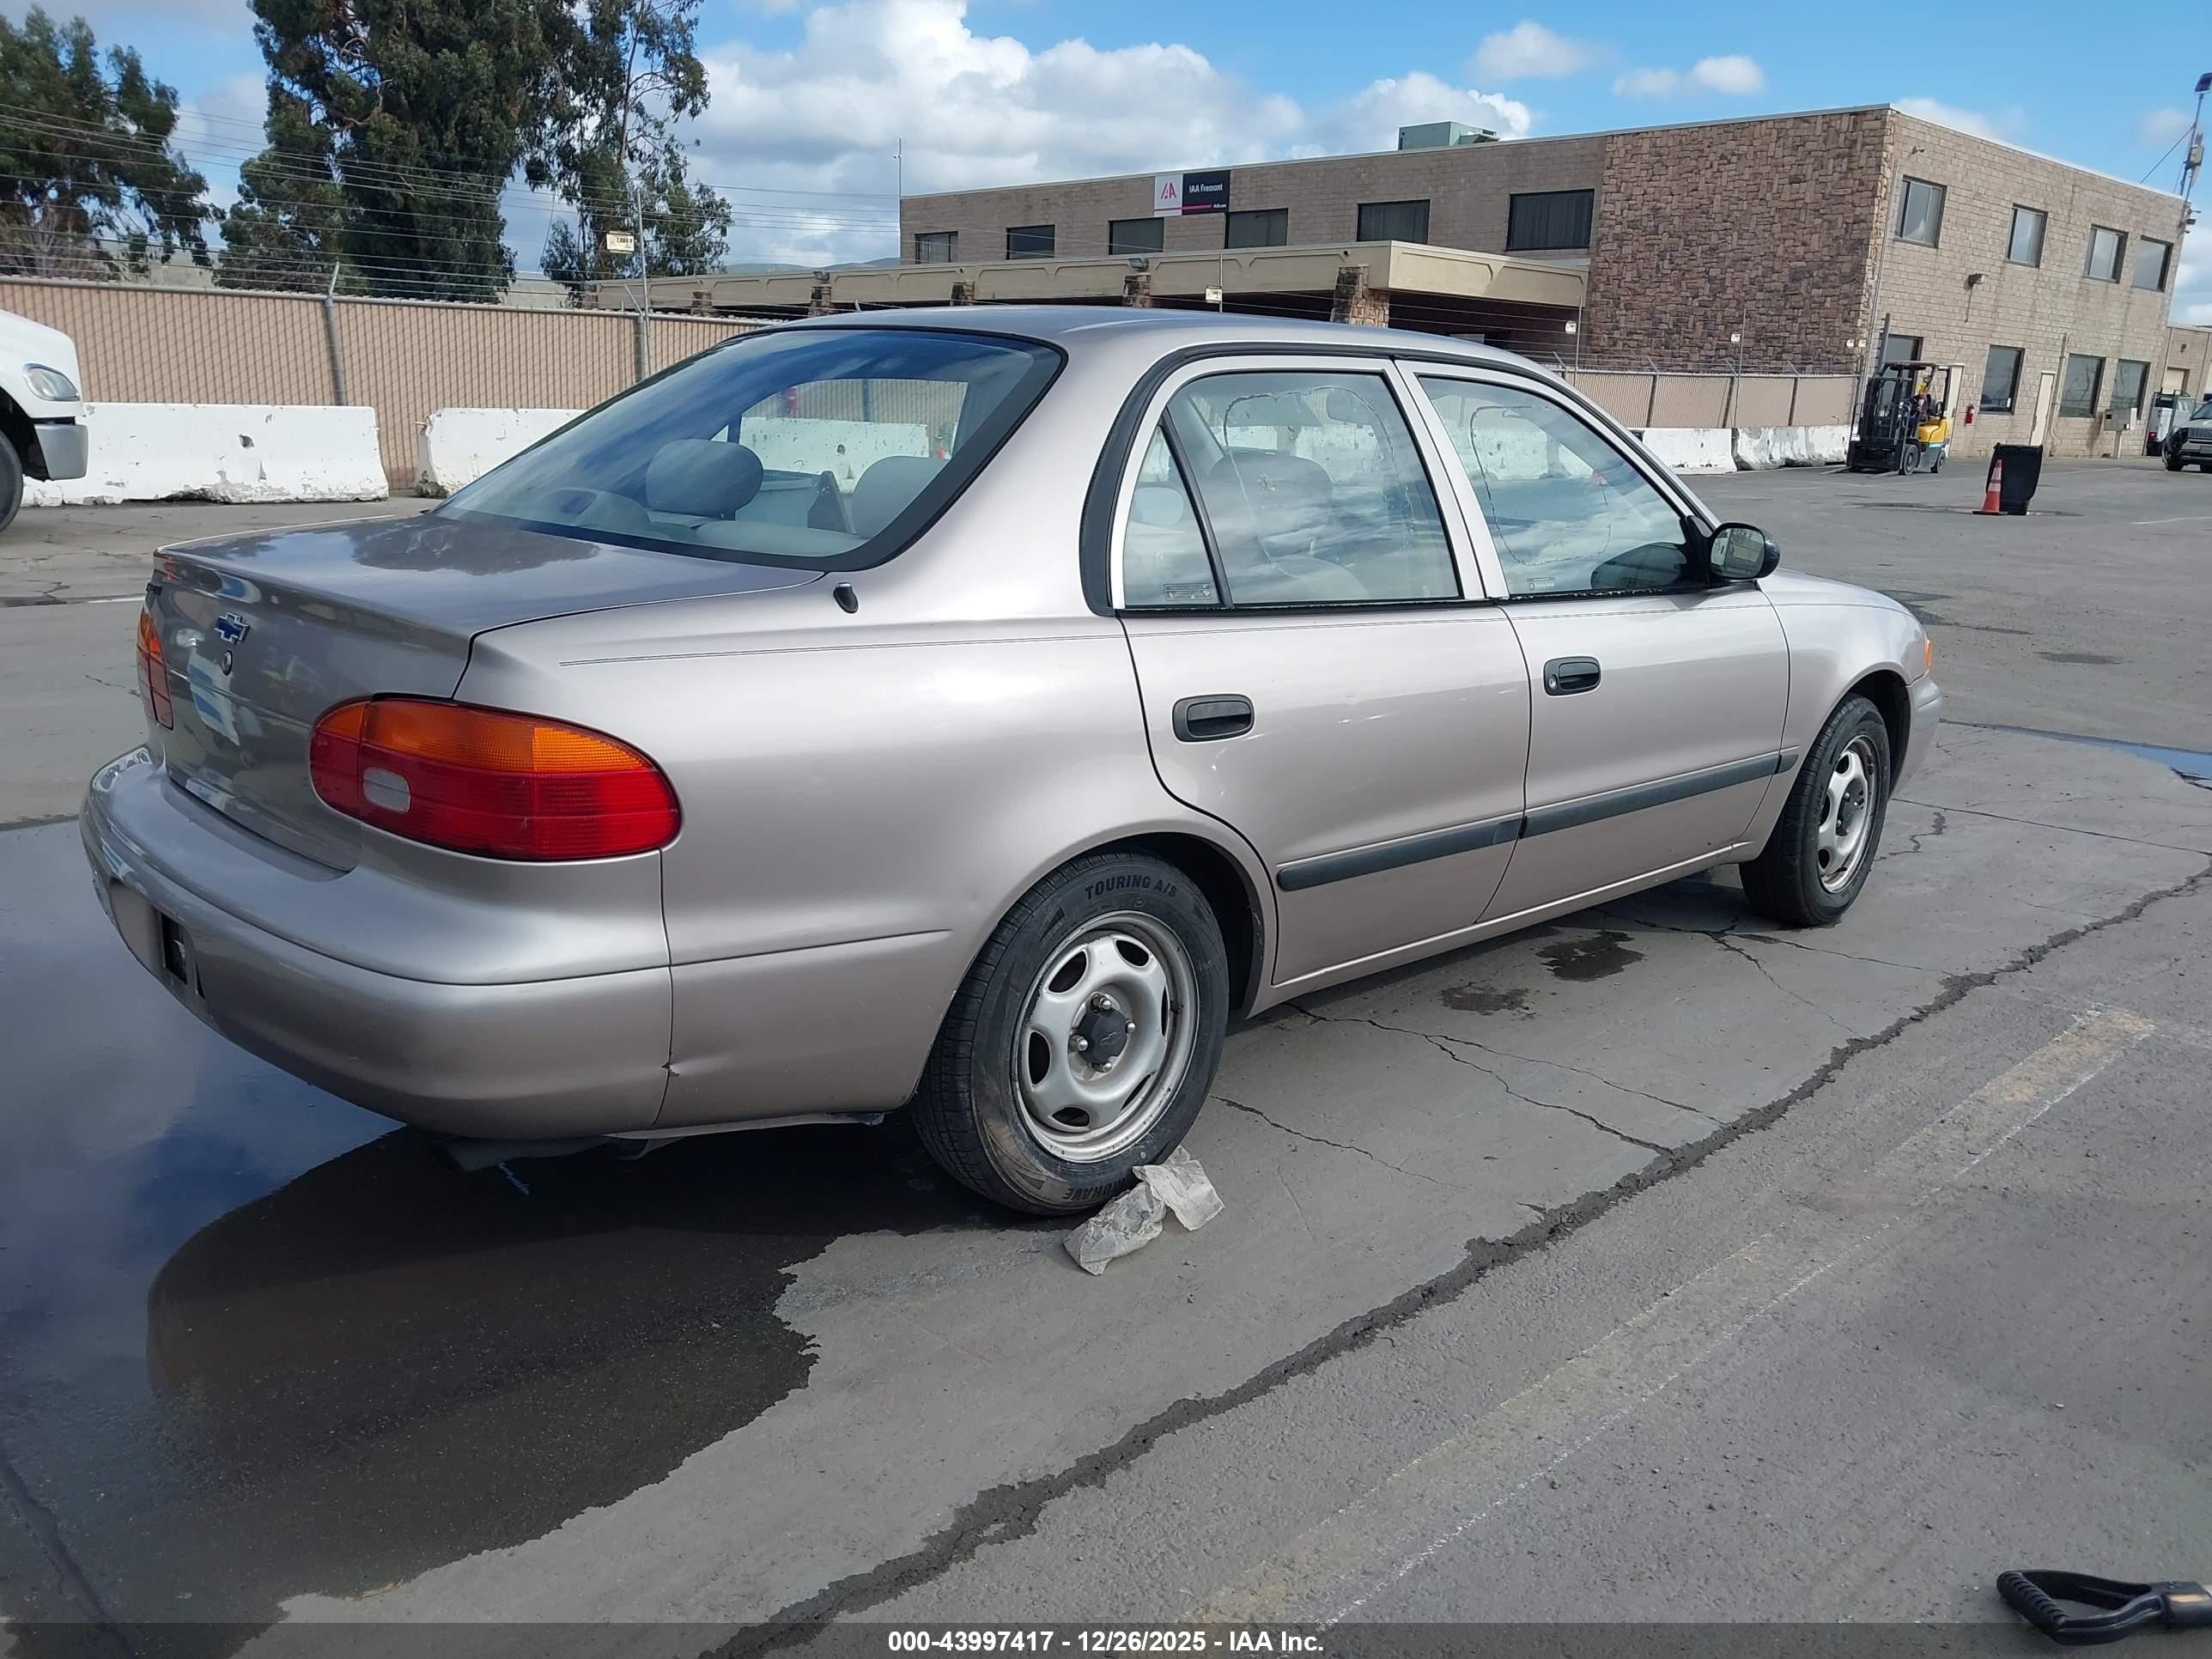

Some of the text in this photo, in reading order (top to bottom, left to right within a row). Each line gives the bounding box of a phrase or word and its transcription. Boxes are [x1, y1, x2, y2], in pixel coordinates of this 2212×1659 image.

[1188, 183, 1224, 193] IAA Fremont
[1085, 874, 1178, 901] TOURING A/S
